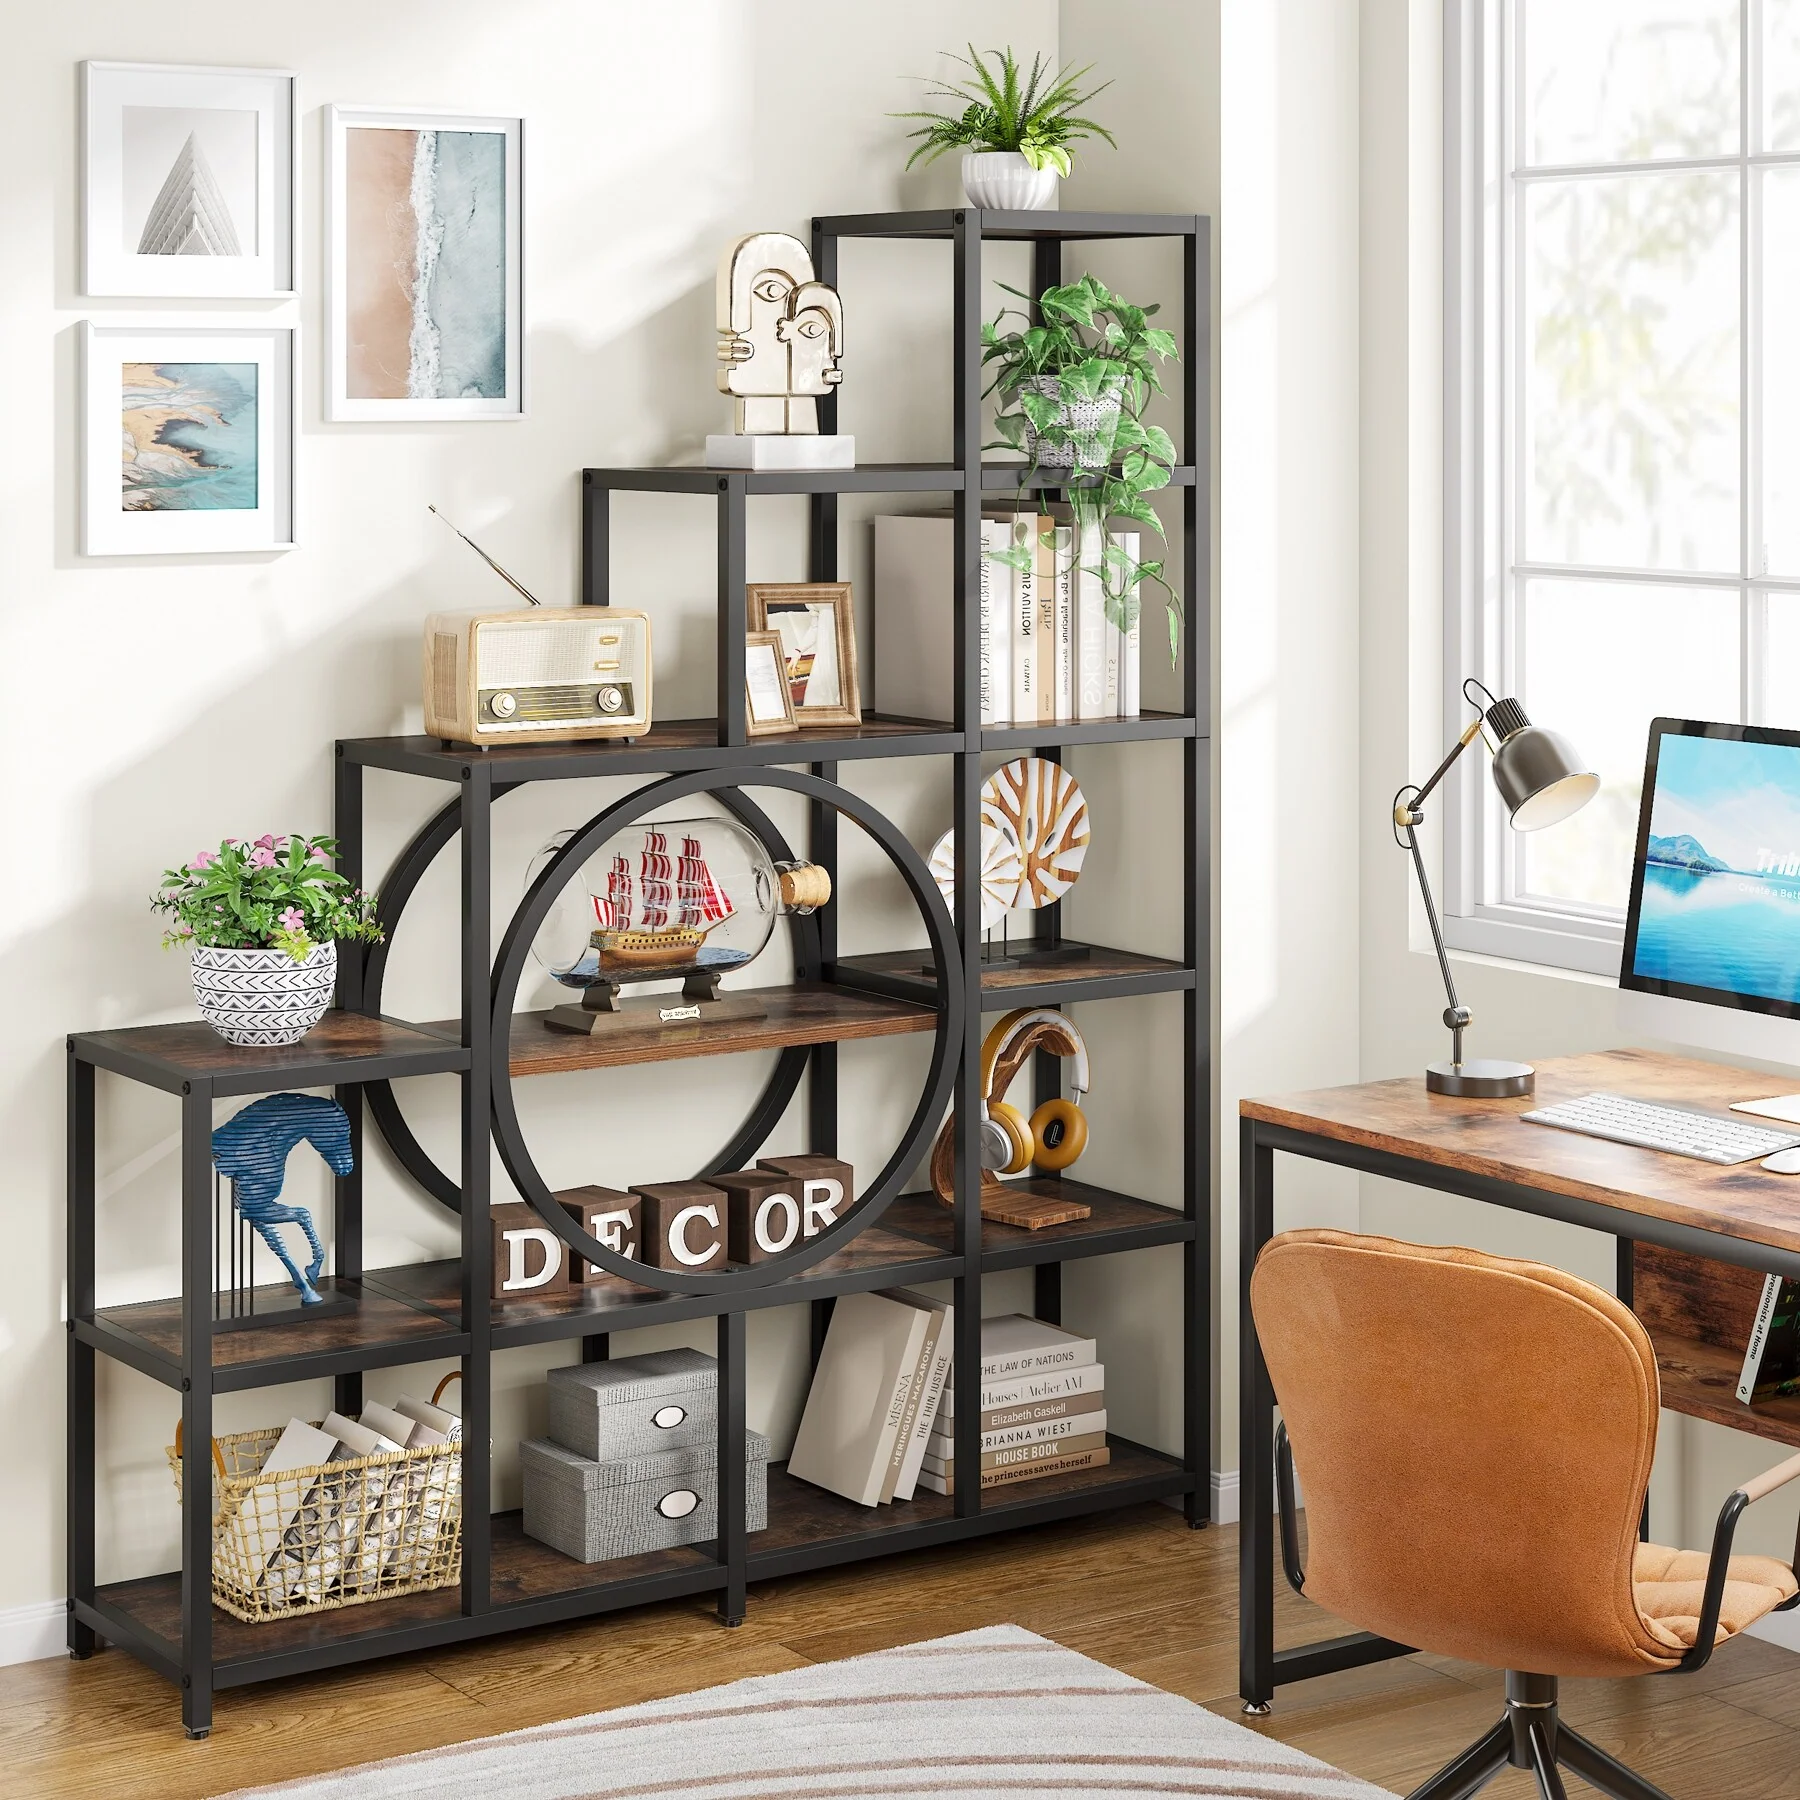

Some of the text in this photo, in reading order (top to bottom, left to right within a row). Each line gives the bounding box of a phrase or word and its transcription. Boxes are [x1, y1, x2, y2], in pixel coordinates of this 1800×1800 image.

[1756, 847, 1800, 877] Trib
[1738, 882, 1770, 896] Create
[1772, 888, 1778, 897] a
[502, 1178, 845, 1291] DECOR
[1756, 1324, 1764, 1334] at
[1750, 1336, 1762, 1360] Home
[980, 1351, 1075, 1376] THE LAW OF NATIONS
[893, 1340, 934, 1467] MERINGUES MACARONS
[917, 1355, 948, 1439] THE THIN JUSTICE
[982, 1392, 1019, 1405] Houses
[1027, 1381, 1062, 1398] Atelier
[991, 1402, 1067, 1426] Elizabeth Gaskell
[1037, 1421, 1073, 1438] WIEST
[995, 1441, 1060, 1465] HOUSE BOOK
[980, 1454, 1093, 1484] he princess saves herself
